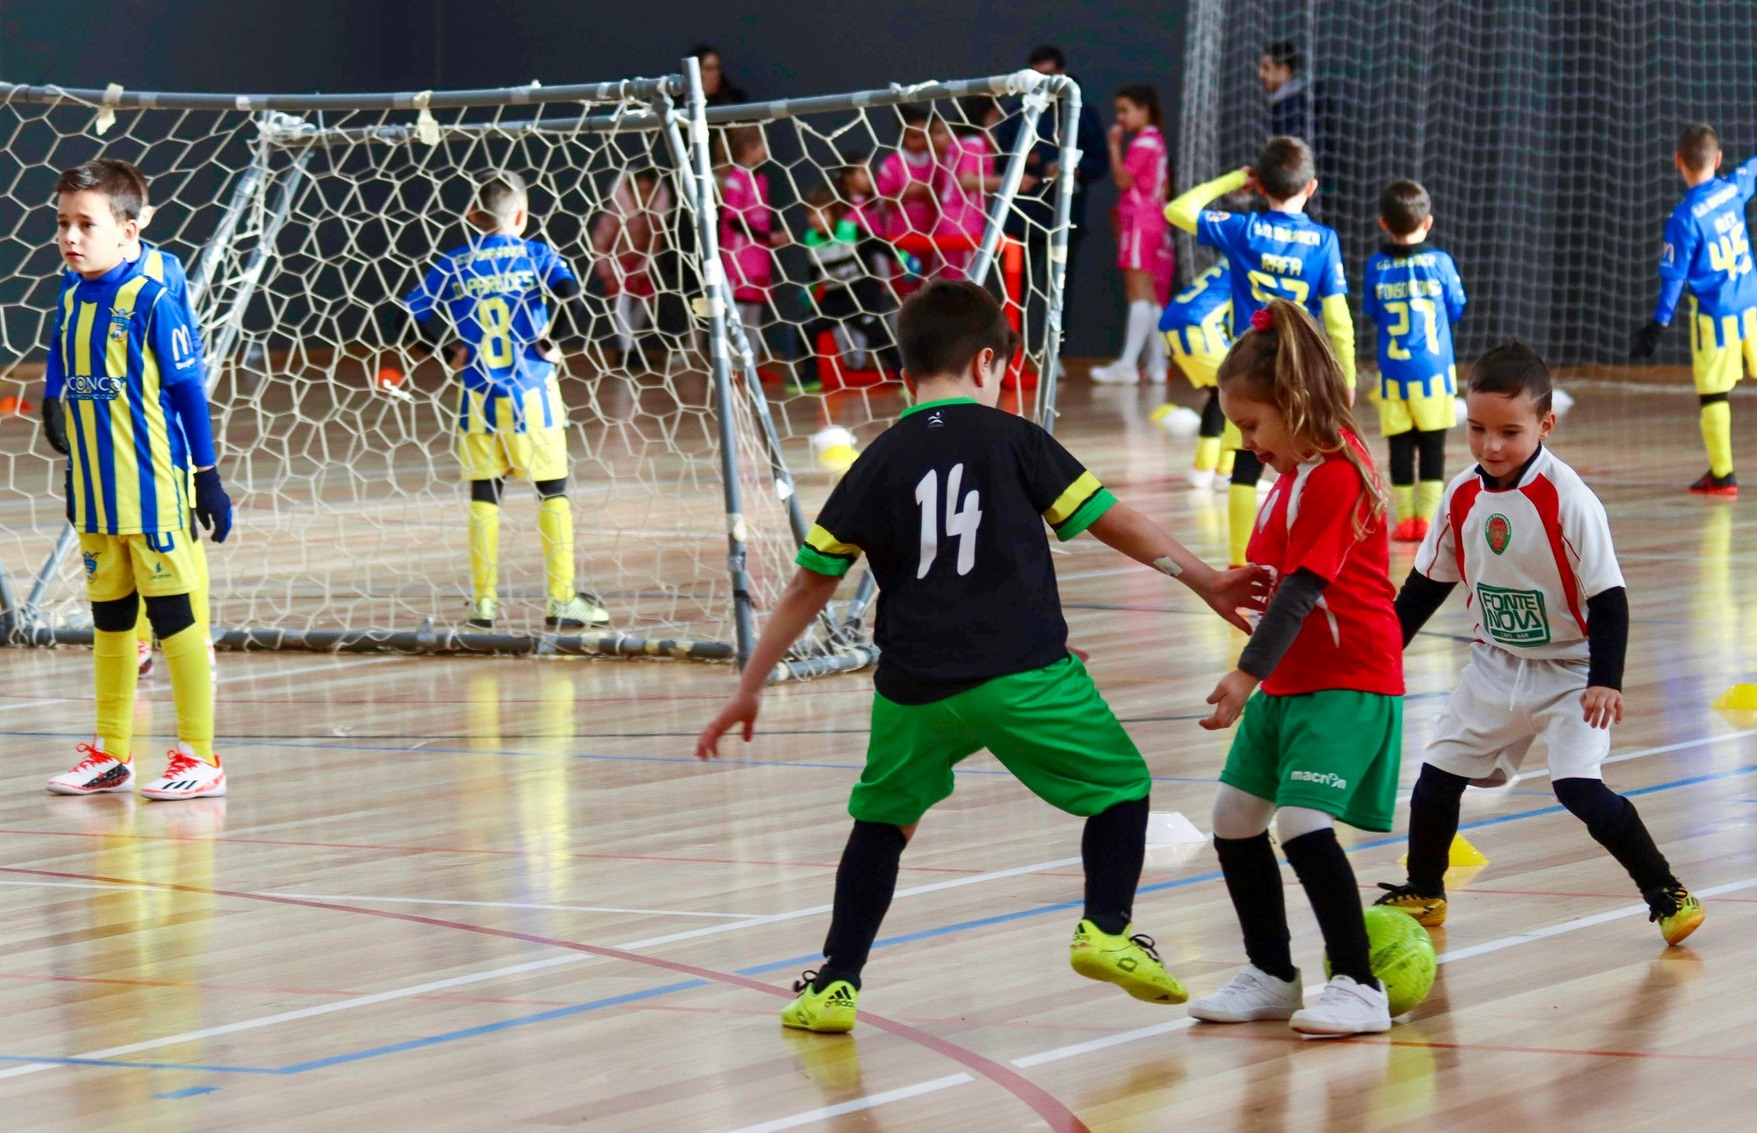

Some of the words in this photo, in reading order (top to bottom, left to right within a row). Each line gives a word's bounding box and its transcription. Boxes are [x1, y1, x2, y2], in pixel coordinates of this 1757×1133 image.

[1261, 252, 1303, 276] RAFA
[478, 297, 514, 369] 8
[914, 462, 983, 580] 14
[1482, 592, 1538, 611] FONTE
[1486, 608, 1543, 631] NOVA
